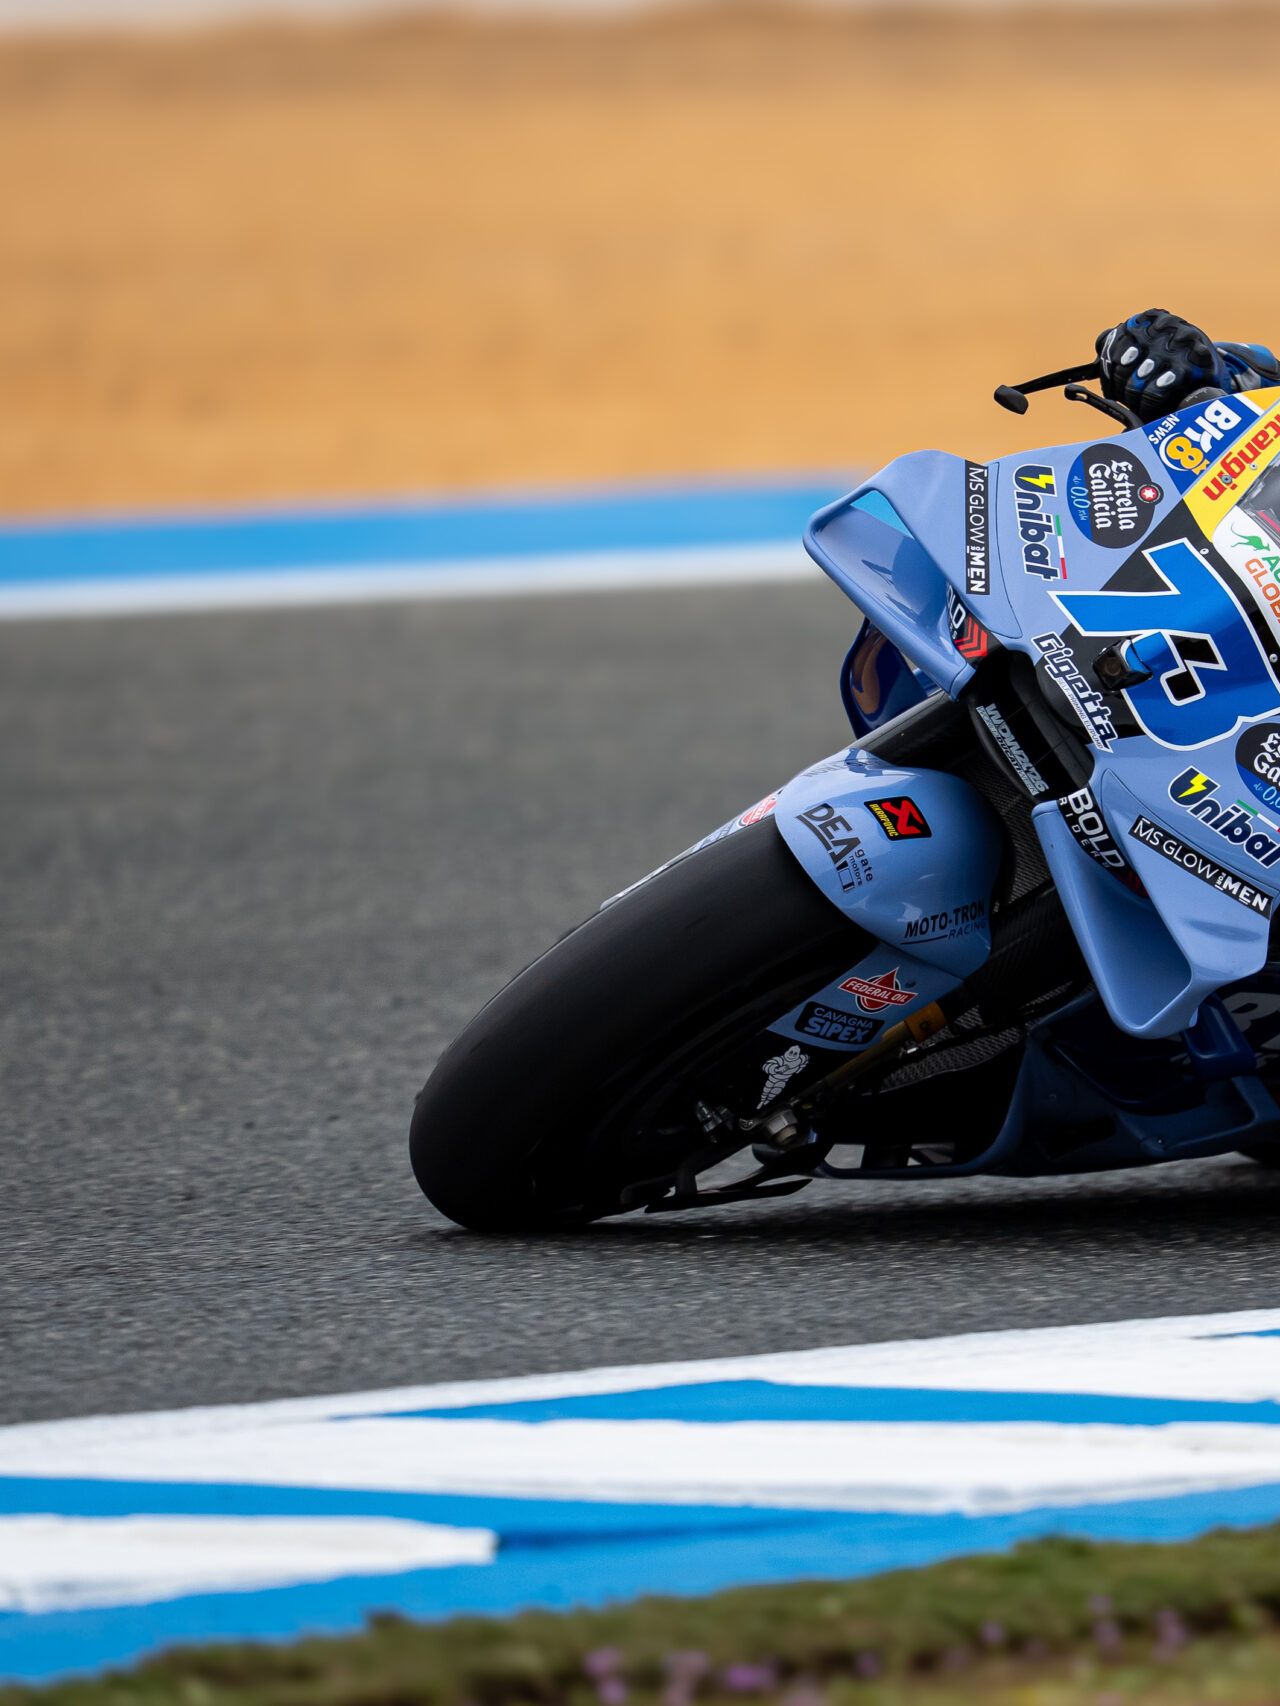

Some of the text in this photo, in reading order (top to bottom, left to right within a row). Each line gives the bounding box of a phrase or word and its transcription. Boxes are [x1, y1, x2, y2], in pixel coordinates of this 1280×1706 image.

[1149, 414, 1180, 445] NEWS
[1162, 399, 1242, 474] BK8
[969, 467, 987, 493] MS
[1088, 463, 1116, 530] Galicia
[1111, 459, 1139, 531] Estrella
[969, 494, 985, 545] GLOW
[1013, 464, 1060, 582] Unibat
[968, 552, 987, 593] MEN
[1031, 631, 1119, 754] Gigetta
[1067, 786, 1125, 869] BOLD
[849, 855, 863, 886] motors
[854, 848, 874, 882] gate
[1133, 817, 1164, 846] MS
[1162, 839, 1219, 880] GLOW
[1223, 874, 1270, 912] MEN
[904, 900, 986, 938] MOTO-TRON
[947, 921, 987, 940] RACING
[846, 980, 909, 1003] FEDERAL OIL
[804, 1016, 871, 1044] SIPEX
[813, 1007, 874, 1029] CAVAGNA
